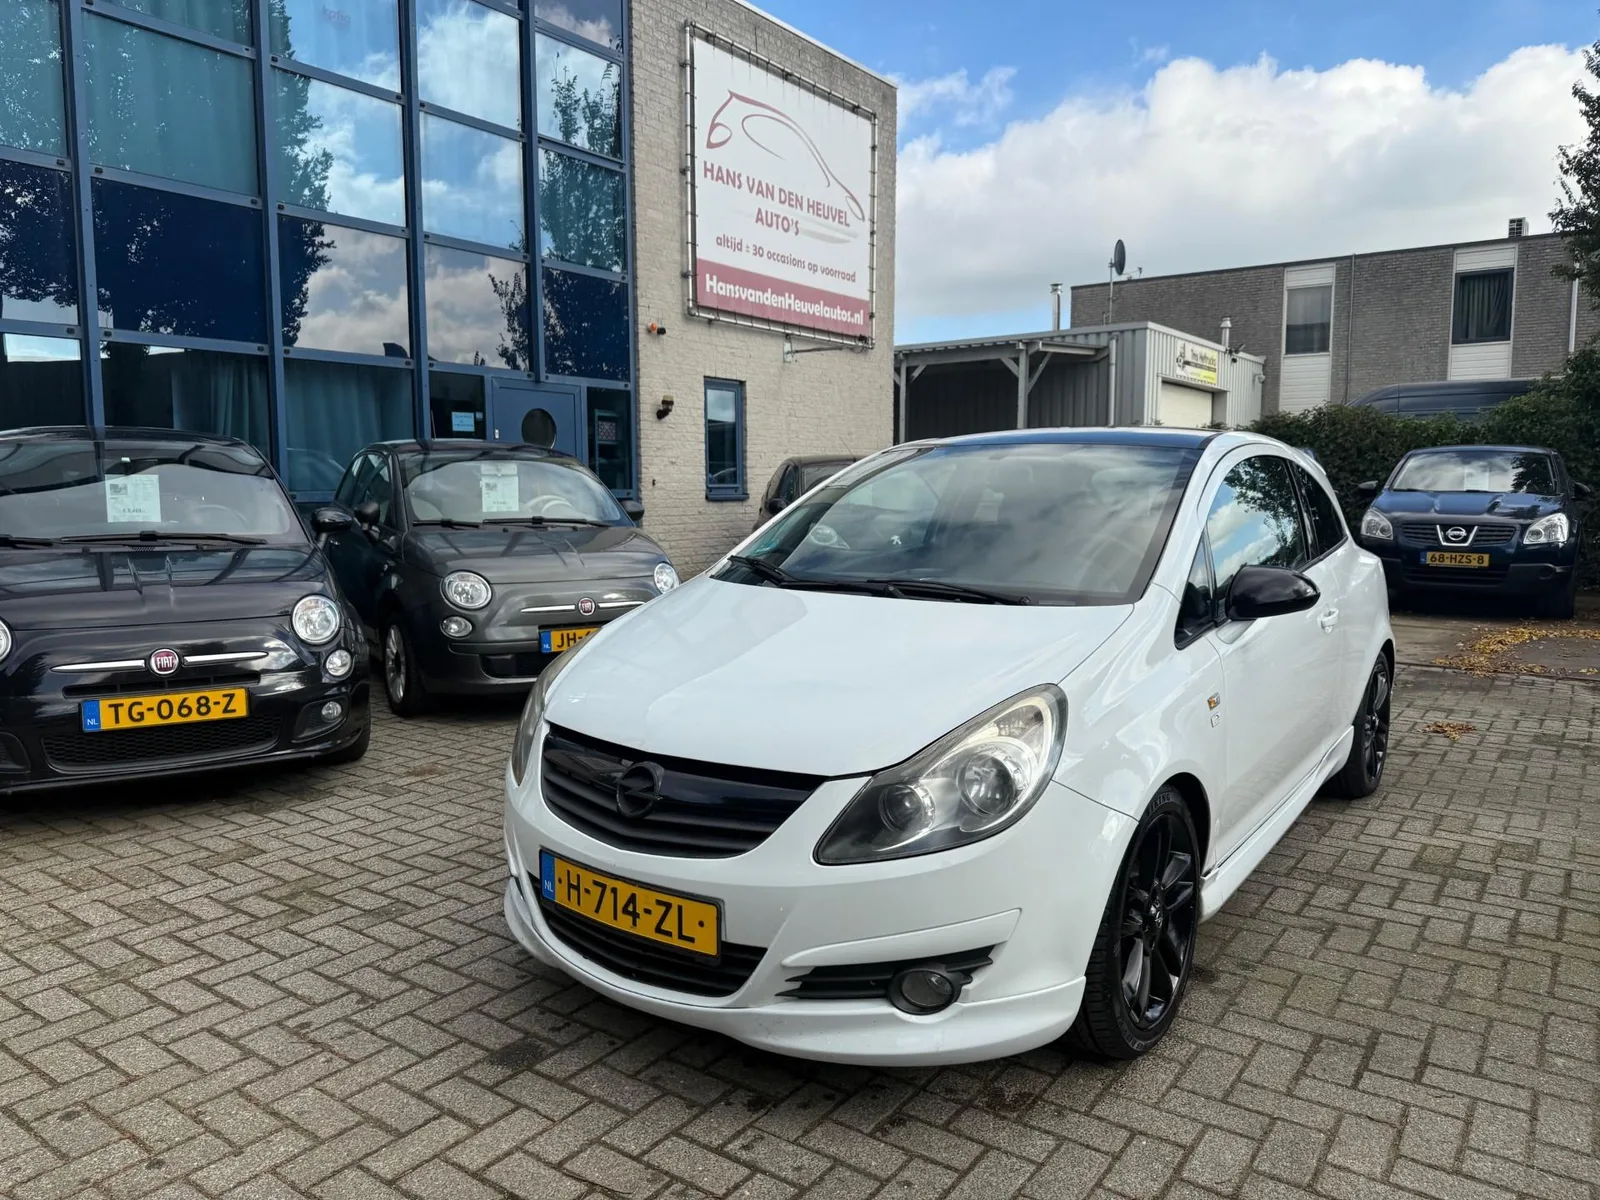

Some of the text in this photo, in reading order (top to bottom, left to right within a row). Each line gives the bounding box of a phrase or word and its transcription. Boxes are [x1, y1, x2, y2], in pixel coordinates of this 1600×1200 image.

[703, 160, 850, 227] HANS VAN DEN HEUVEL
[755, 206, 800, 237] AUTO'S
[715, 234, 743, 252] altijd
[752, 245, 764, 258] 30
[766, 250, 806, 270] occasions
[807, 262, 819, 275] op
[820, 265, 857, 284] voorraad
[705, 273, 864, 326] HansvandenHeuvelautos.nl
[1430, 553, 1484, 565] 68-HZS-8
[157, 656, 174, 669] FIAT
[87, 718, 98, 726] NL
[108, 693, 237, 725] TG-068-Z
[544, 879, 554, 893] NL
[566, 869, 696, 944] H-714-ZL
